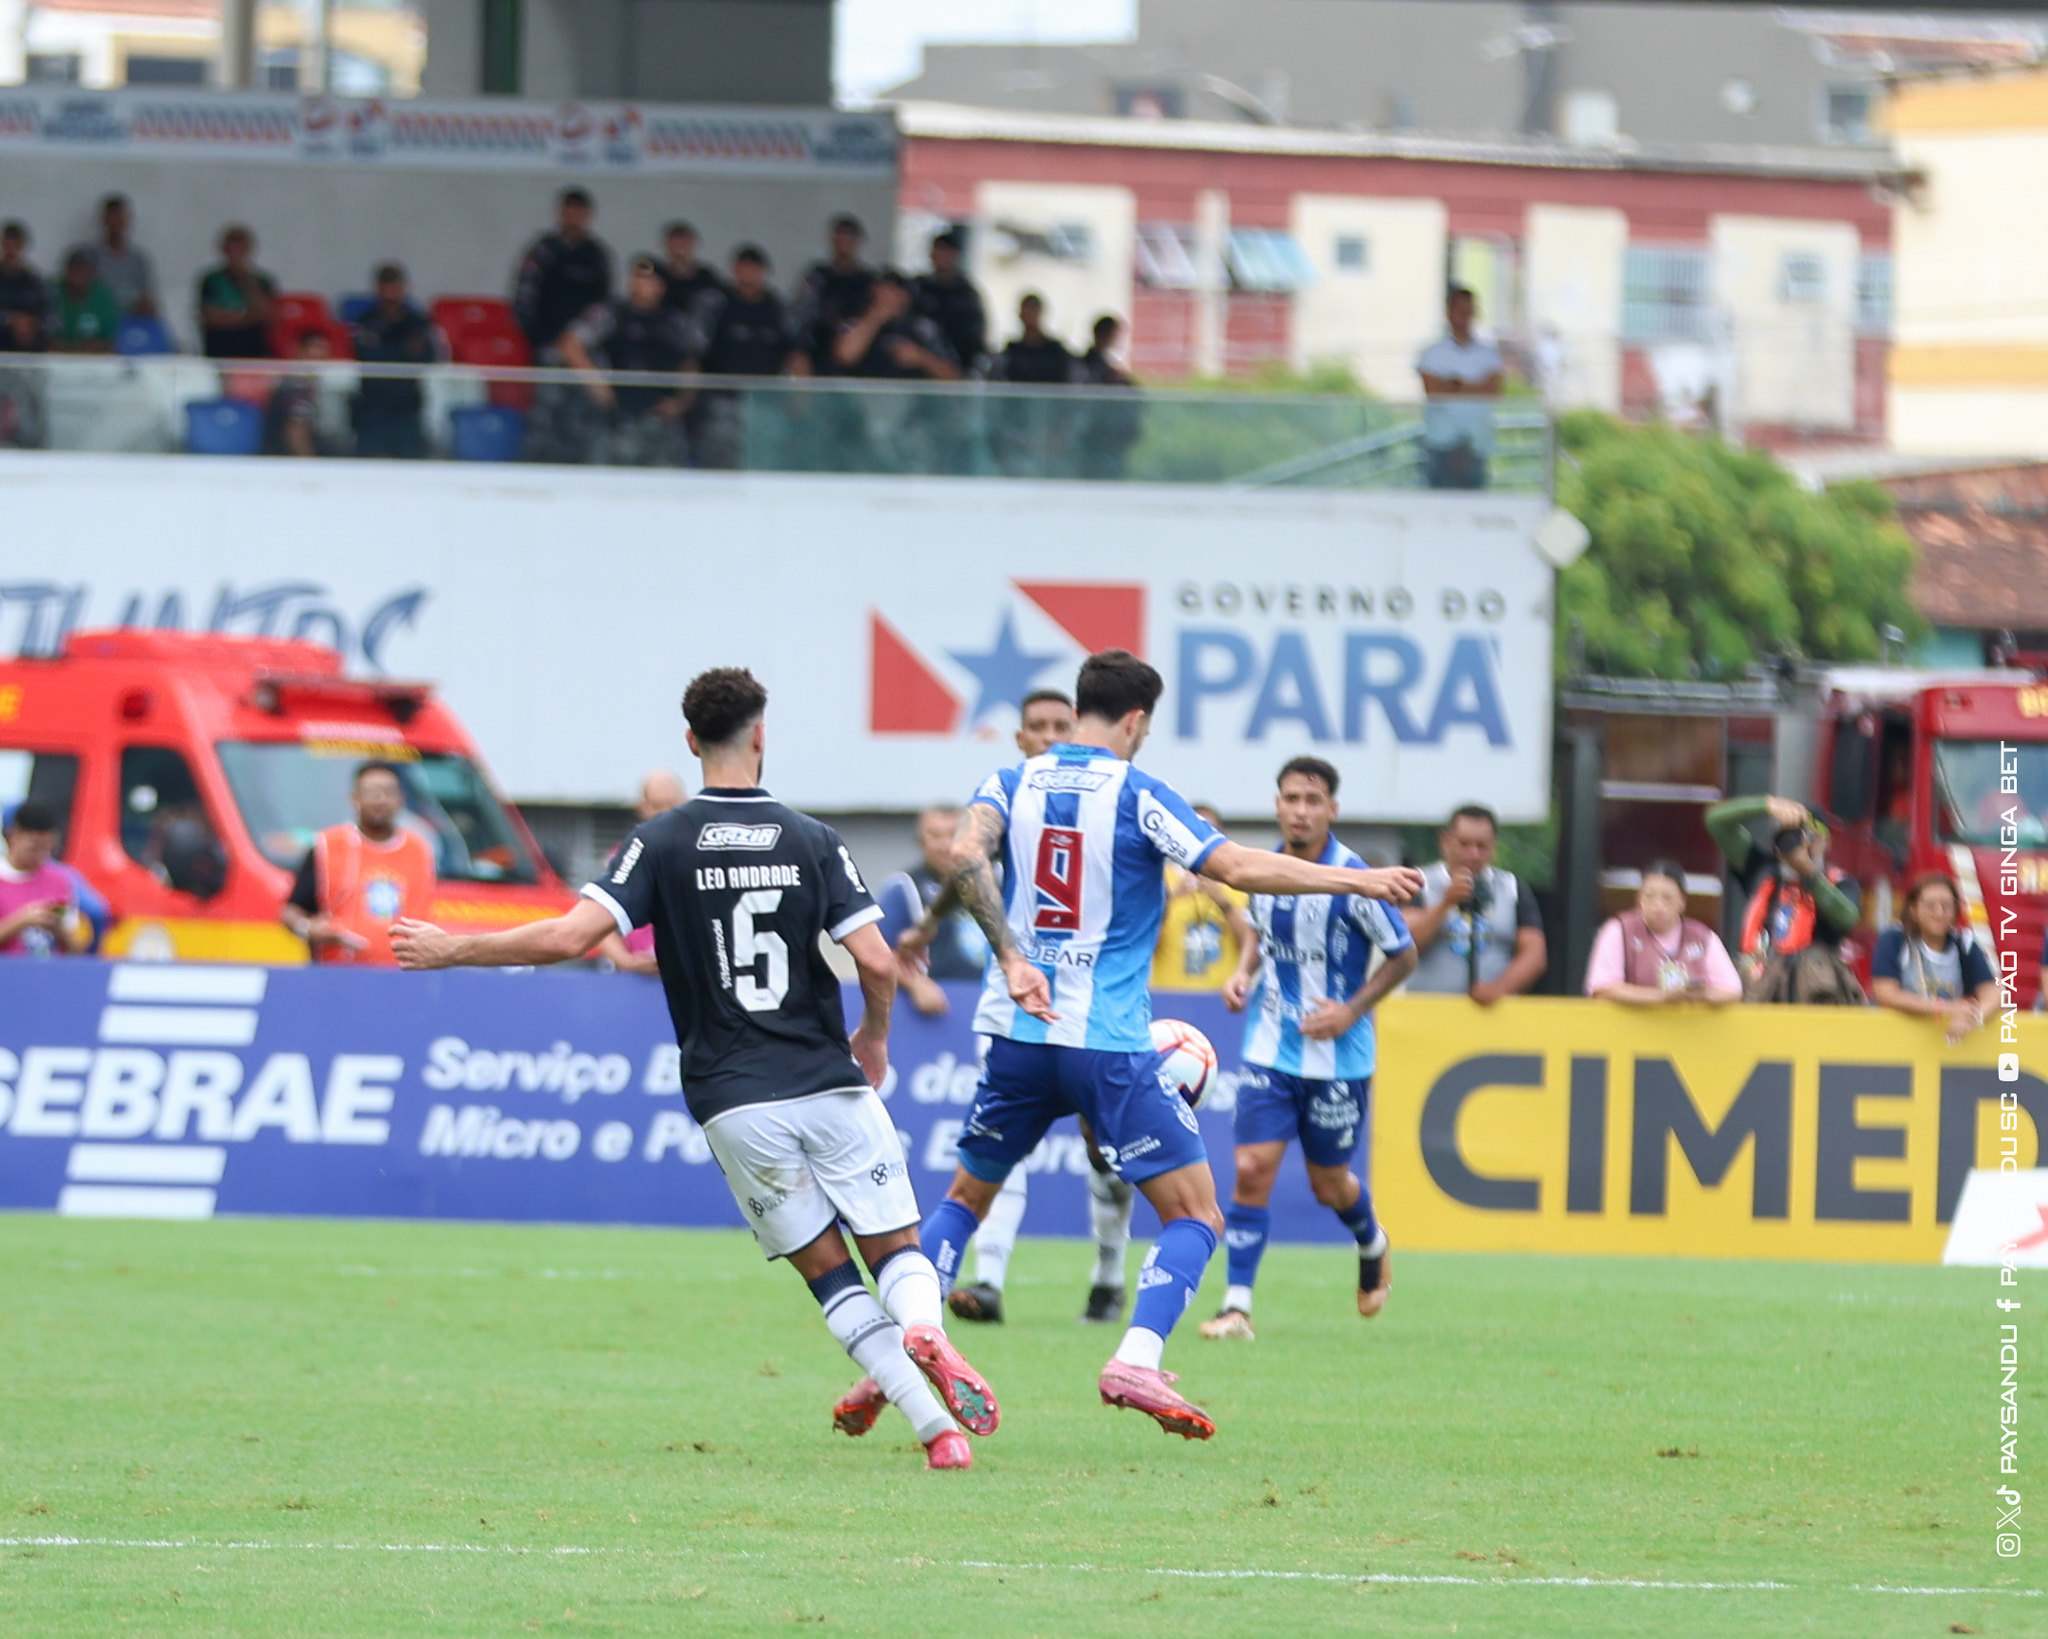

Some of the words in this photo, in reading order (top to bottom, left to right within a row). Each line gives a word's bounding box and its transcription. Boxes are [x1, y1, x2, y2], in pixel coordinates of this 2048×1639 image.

[1176, 581, 1413, 621] GOVERNO
[1440, 586, 1508, 622] DO
[1176, 625, 1516, 750] PARÁ
[1143, 810, 1188, 859] Ginga
[696, 868, 726, 891] LEO
[728, 865, 802, 889] ANDRADE
[1034, 827, 1083, 931] 9
[732, 889, 790, 1012] 5
[422, 1036, 632, 1103] Serviço
[419, 1105, 581, 1161] Micro
[592, 1121, 633, 1162] e
